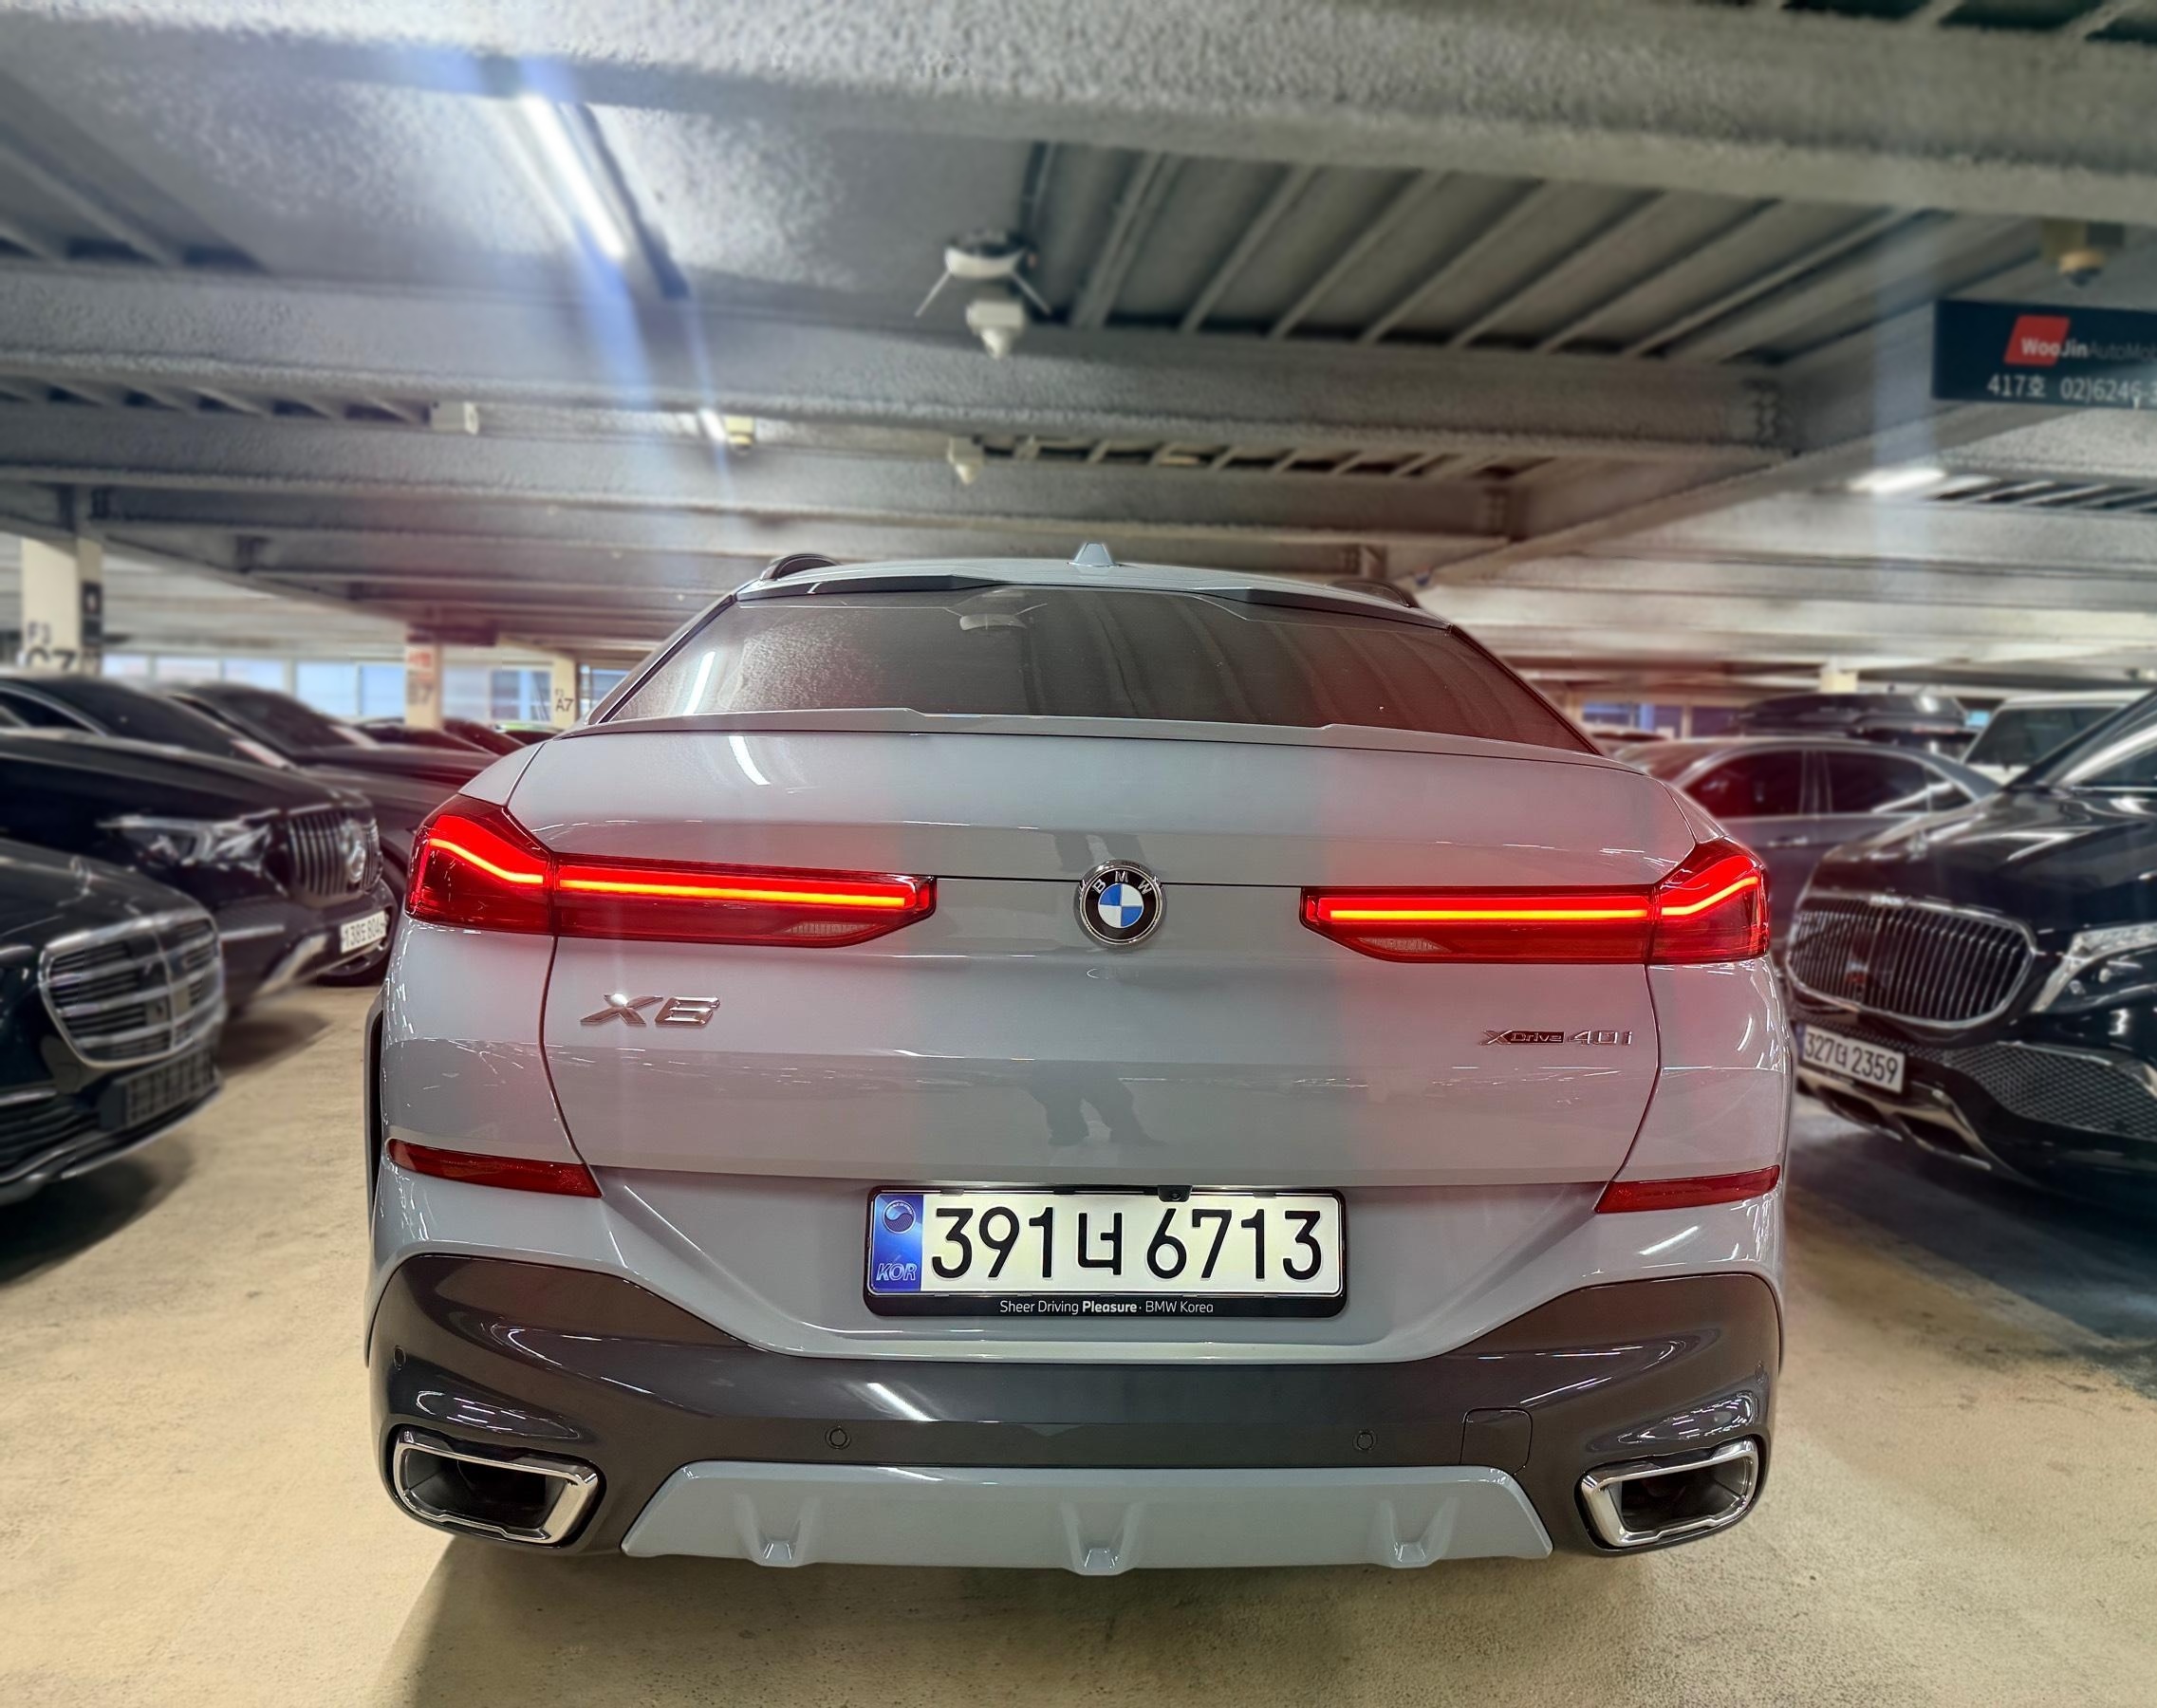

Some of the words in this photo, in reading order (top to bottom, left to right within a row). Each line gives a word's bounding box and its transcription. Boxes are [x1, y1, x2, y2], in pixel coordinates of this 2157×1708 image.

[1987, 374, 2046, 398] 417호
[555, 698, 574, 712] A7
[1092, 870, 1152, 895] BMW
[580, 993, 721, 1026] X6
[1850, 1047, 1899, 1084] 2359
[876, 1263, 918, 1280] KOR
[999, 1300, 1034, 1312] Sheer
[1038, 1300, 1079, 1315] Driving
[1082, 1300, 1138, 1313] Pleasure
[1145, 1300, 1177, 1312] BMW
[1180, 1300, 1214, 1312] Korea
